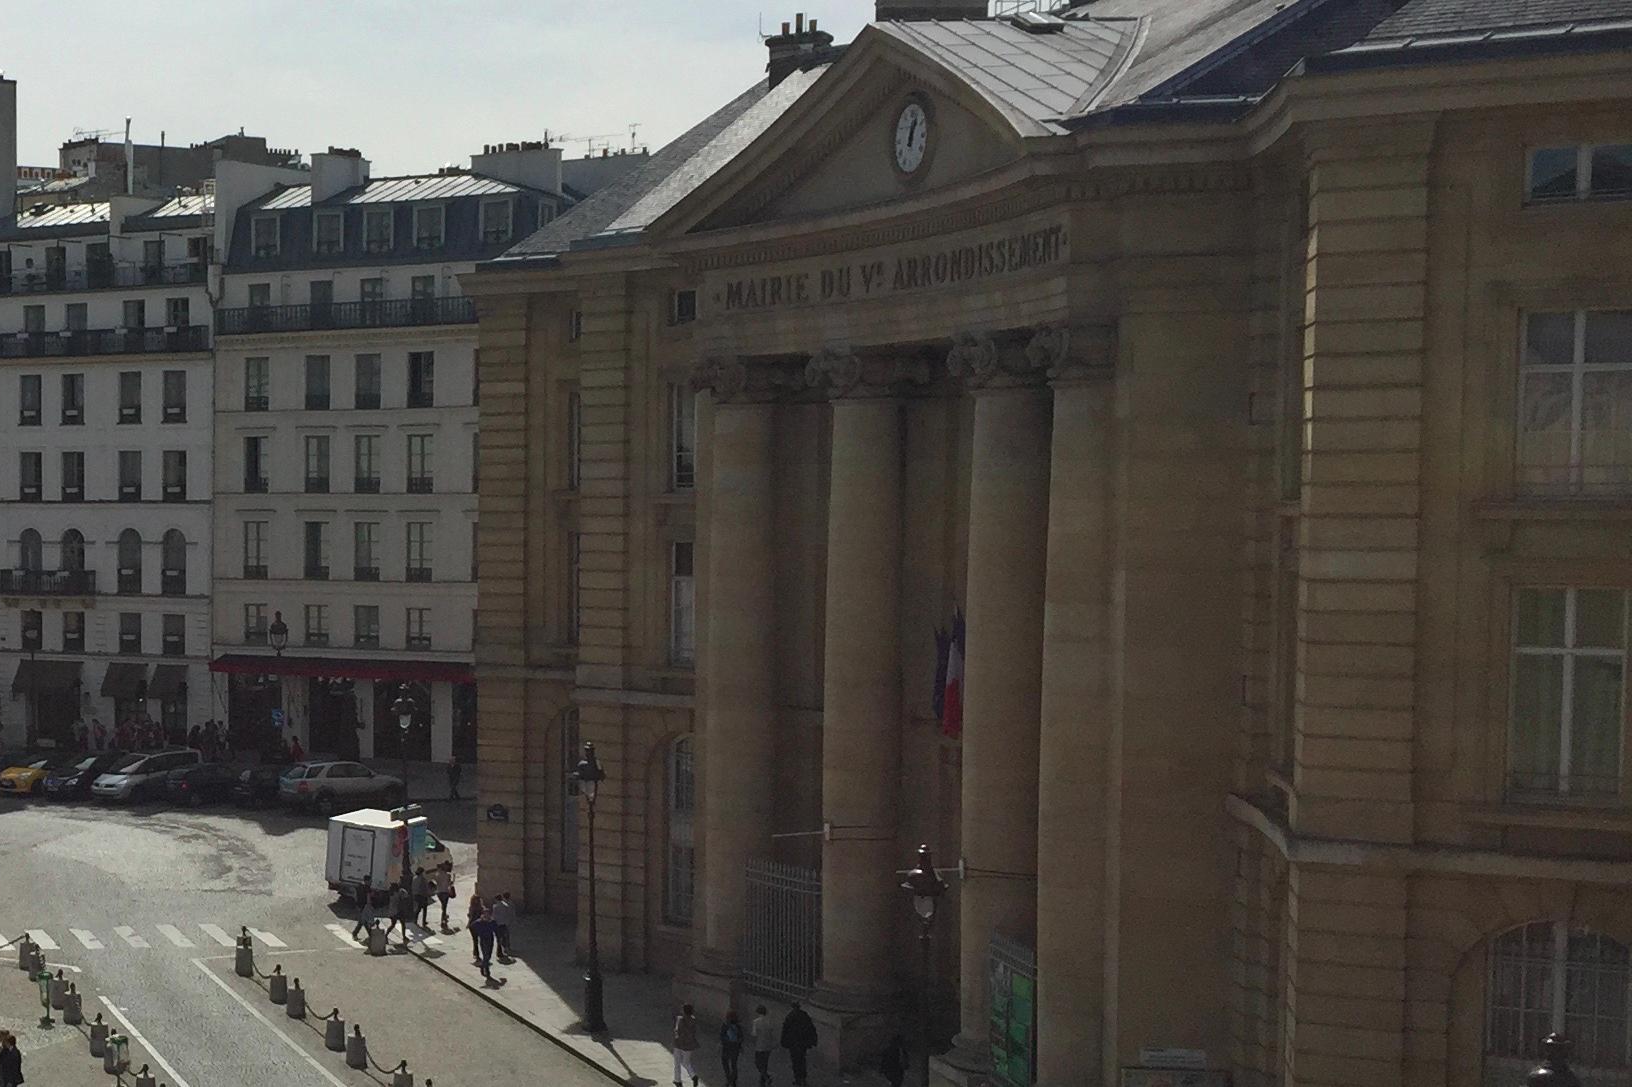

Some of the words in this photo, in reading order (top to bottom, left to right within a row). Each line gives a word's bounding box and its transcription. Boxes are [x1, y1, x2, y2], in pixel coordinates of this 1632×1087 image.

[726, 273, 810, 310] MAIRIE
[820, 264, 851, 299] DU
[892, 224, 1062, 291] ARRONDISSEMENT
